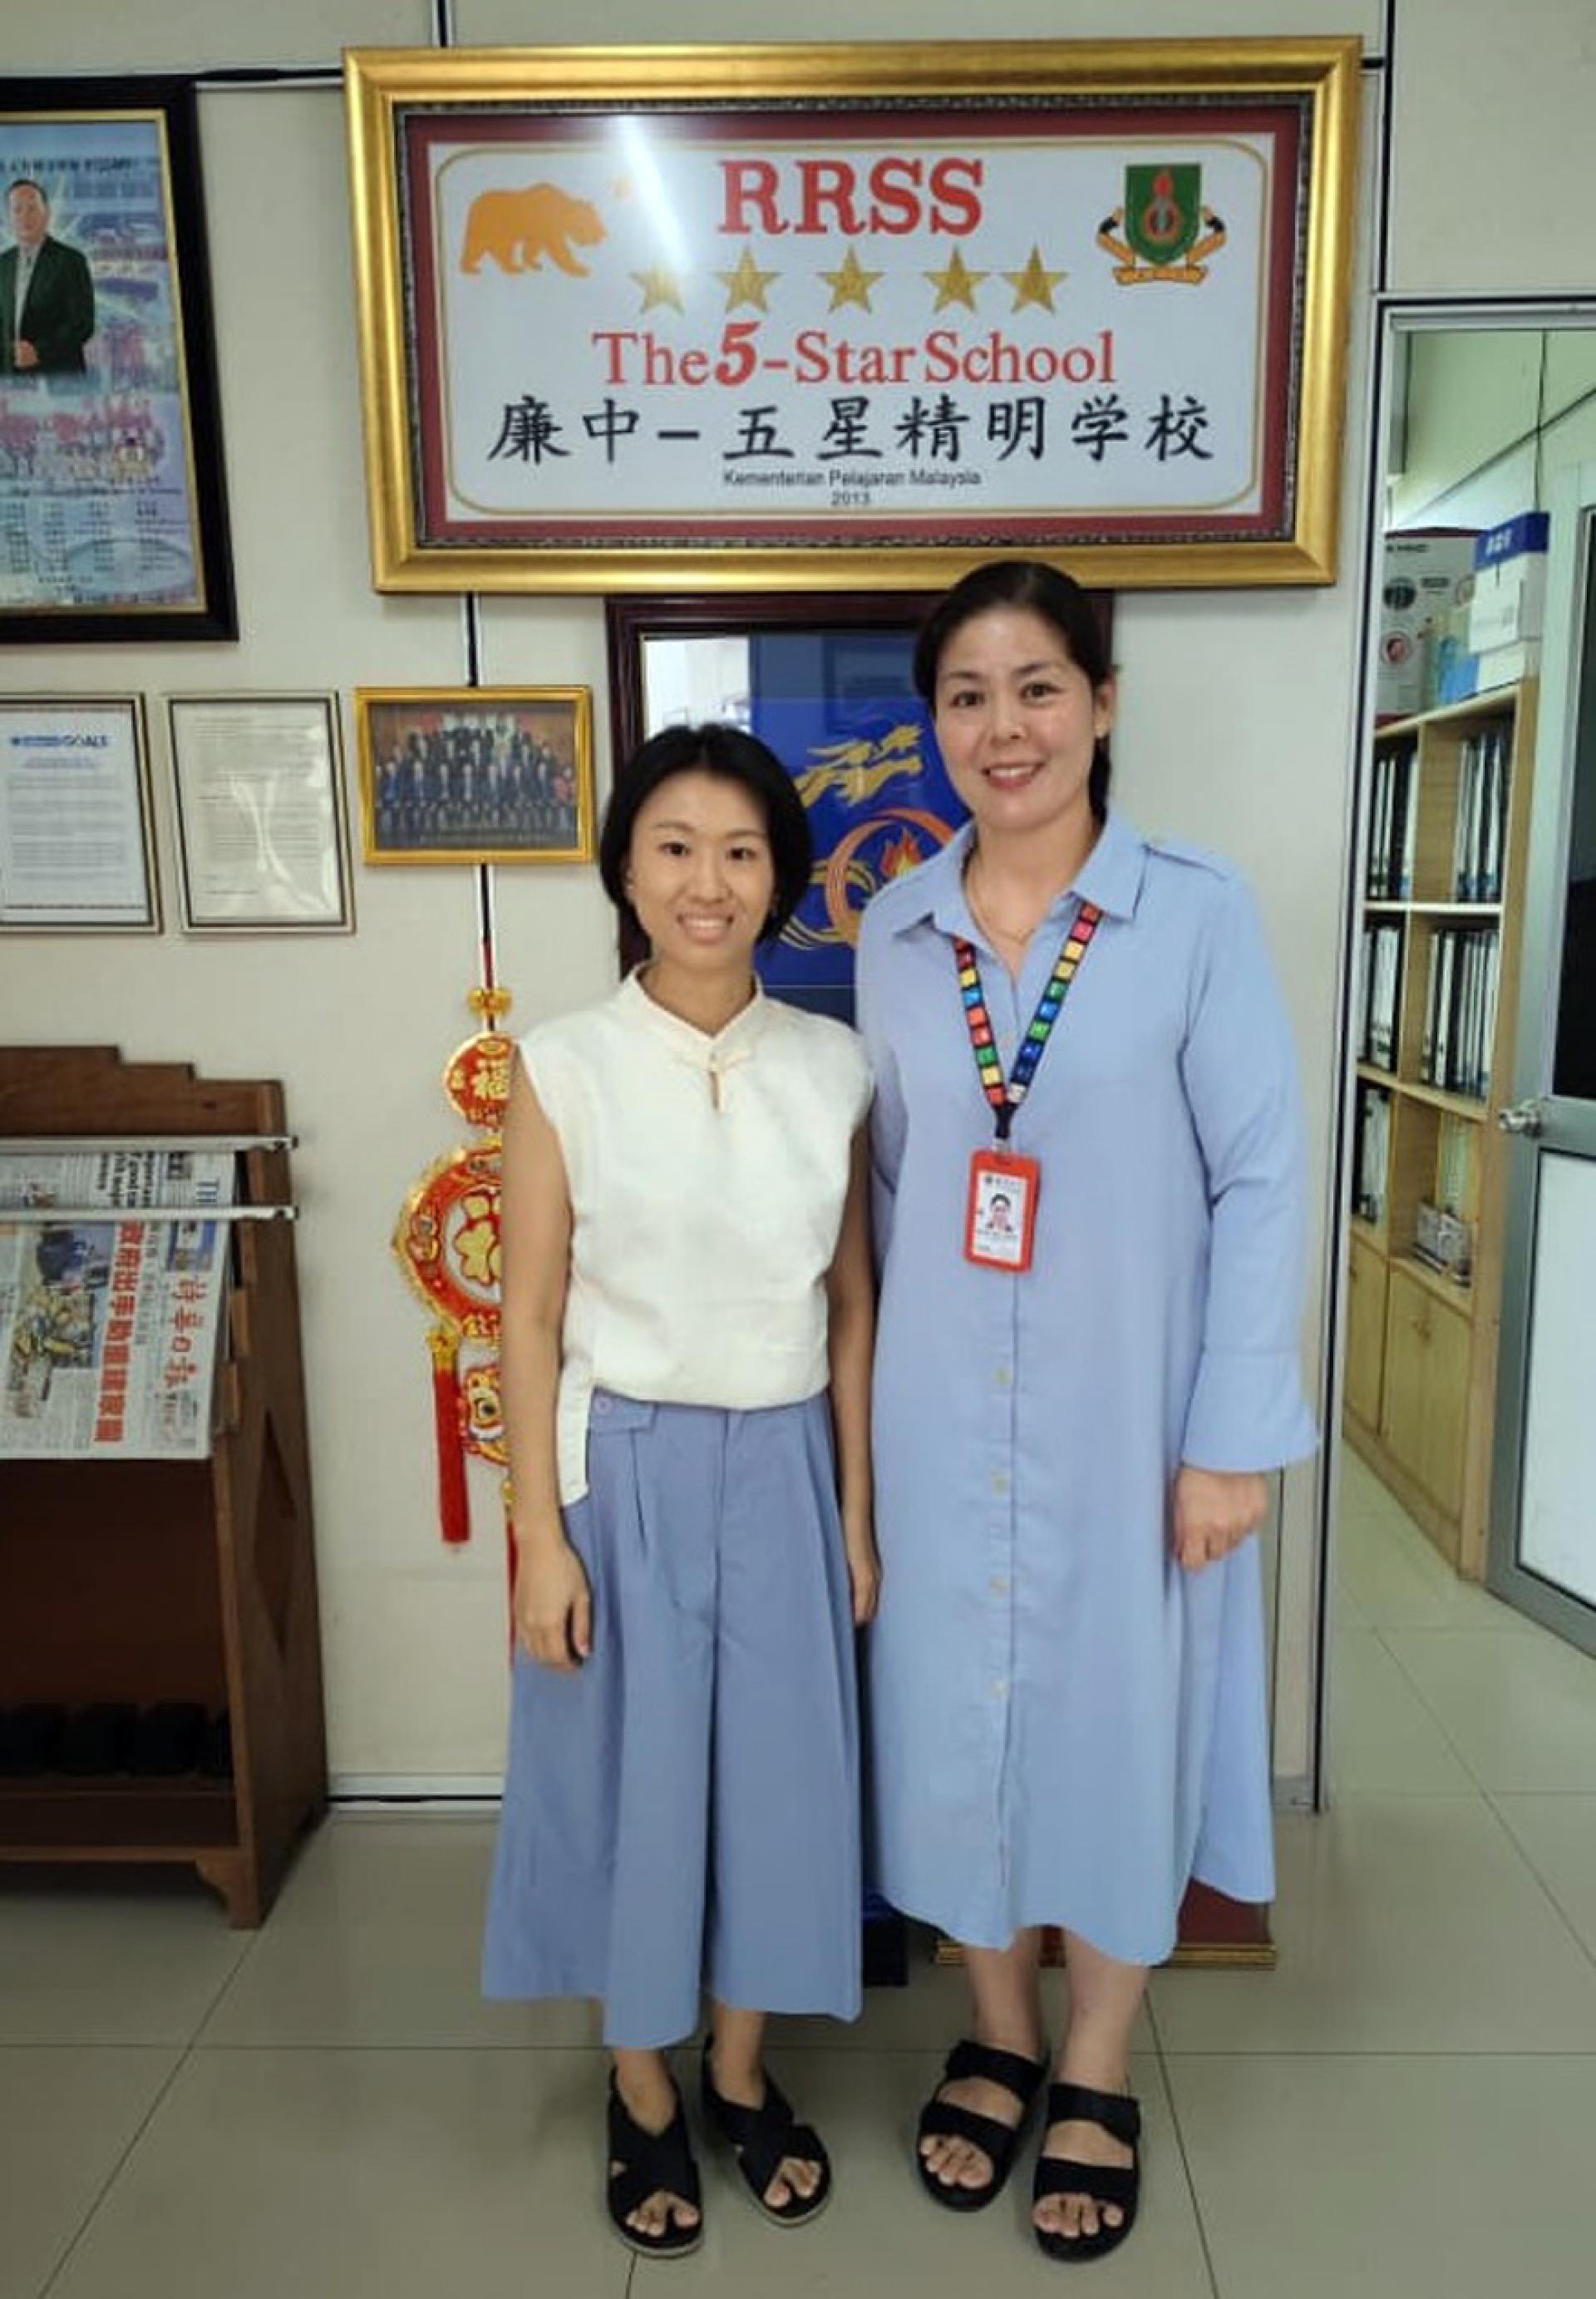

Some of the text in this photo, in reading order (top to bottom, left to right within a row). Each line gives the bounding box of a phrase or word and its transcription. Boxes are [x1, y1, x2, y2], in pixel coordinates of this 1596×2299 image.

[717, 156, 984, 237] RRSS
[592, 321, 1115, 387] The 5-Star School
[723, 466, 983, 489] Kementerian Pelajaran Malaysia
[830, 490, 872, 507] 2013
